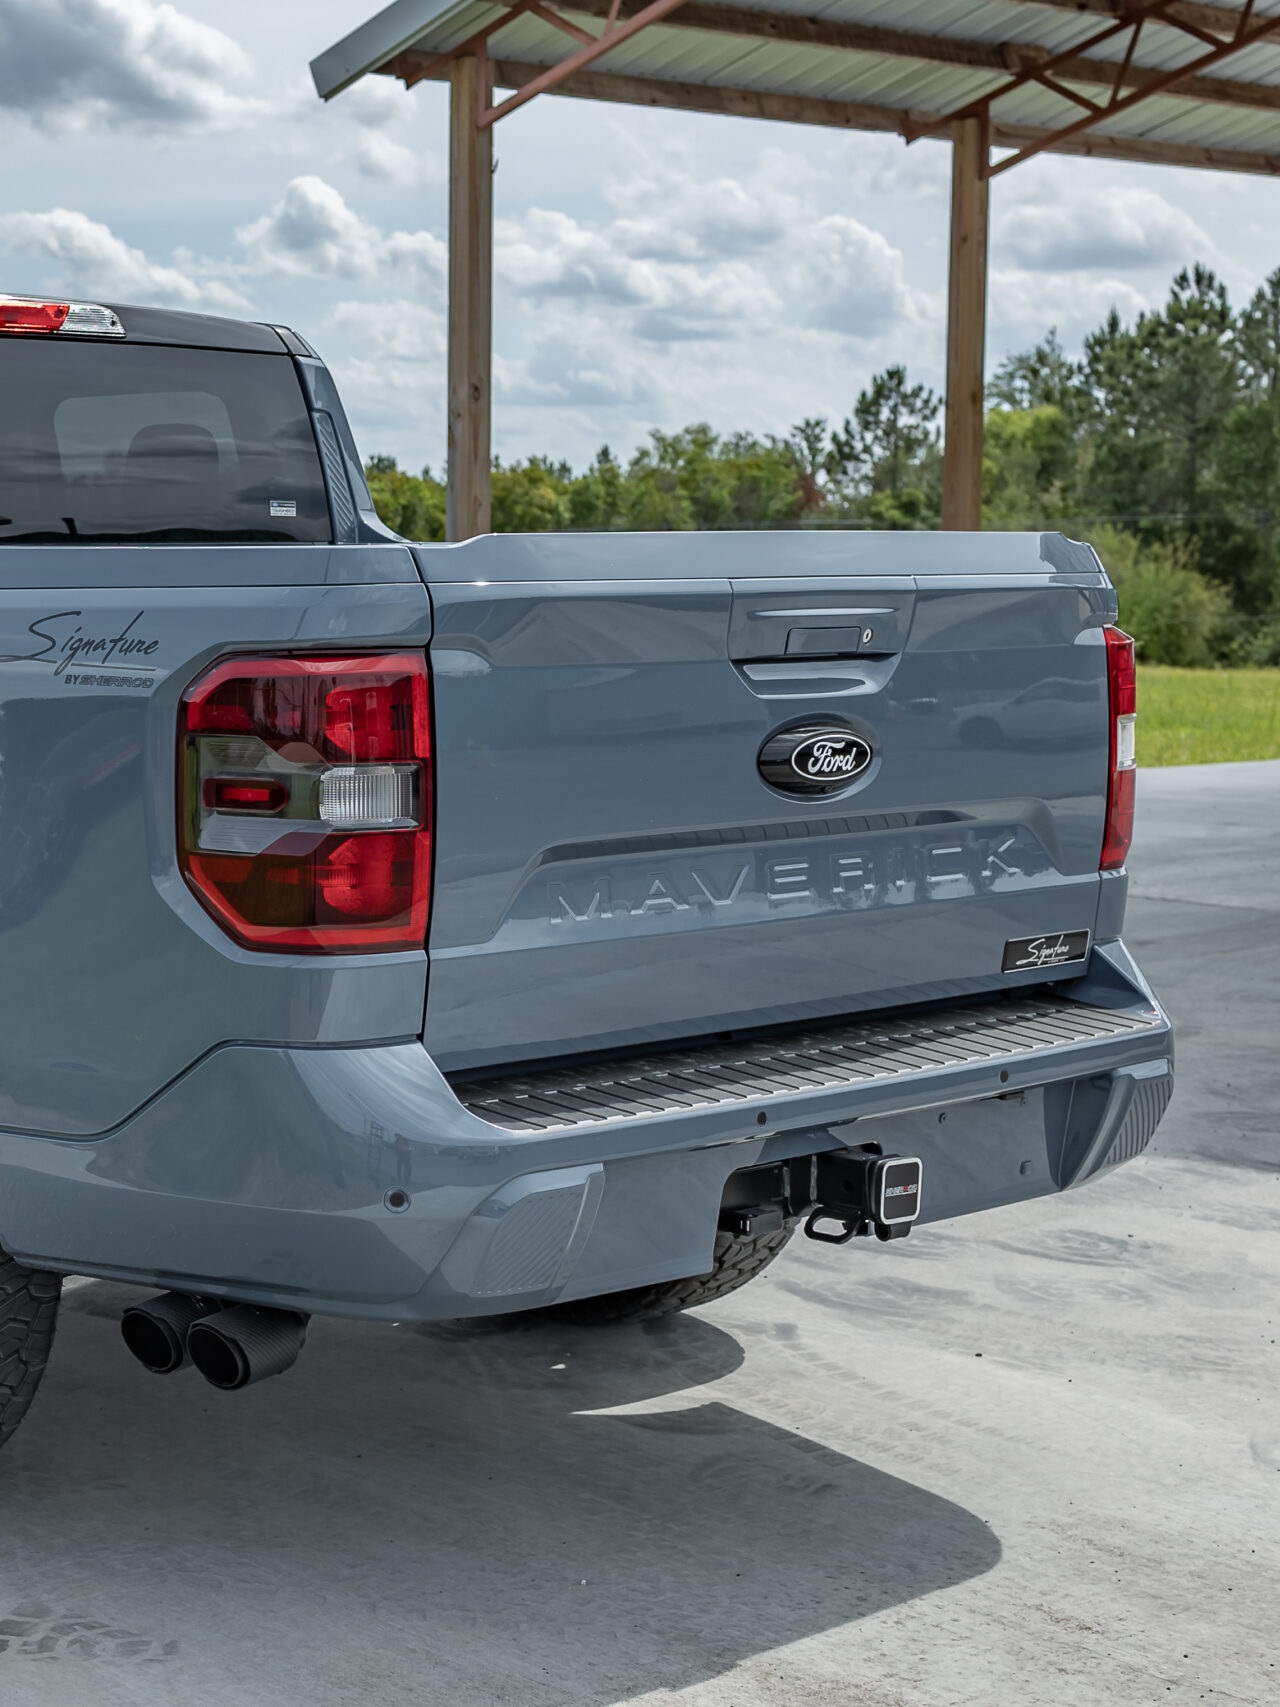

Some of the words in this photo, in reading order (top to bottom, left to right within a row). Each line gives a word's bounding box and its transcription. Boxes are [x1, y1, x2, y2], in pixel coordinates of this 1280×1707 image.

[64, 674, 80, 686] BY
[79, 675, 155, 689] SHERROD
[808, 741, 857, 774] Ford
[546, 837, 1021, 925] MAVERICK
